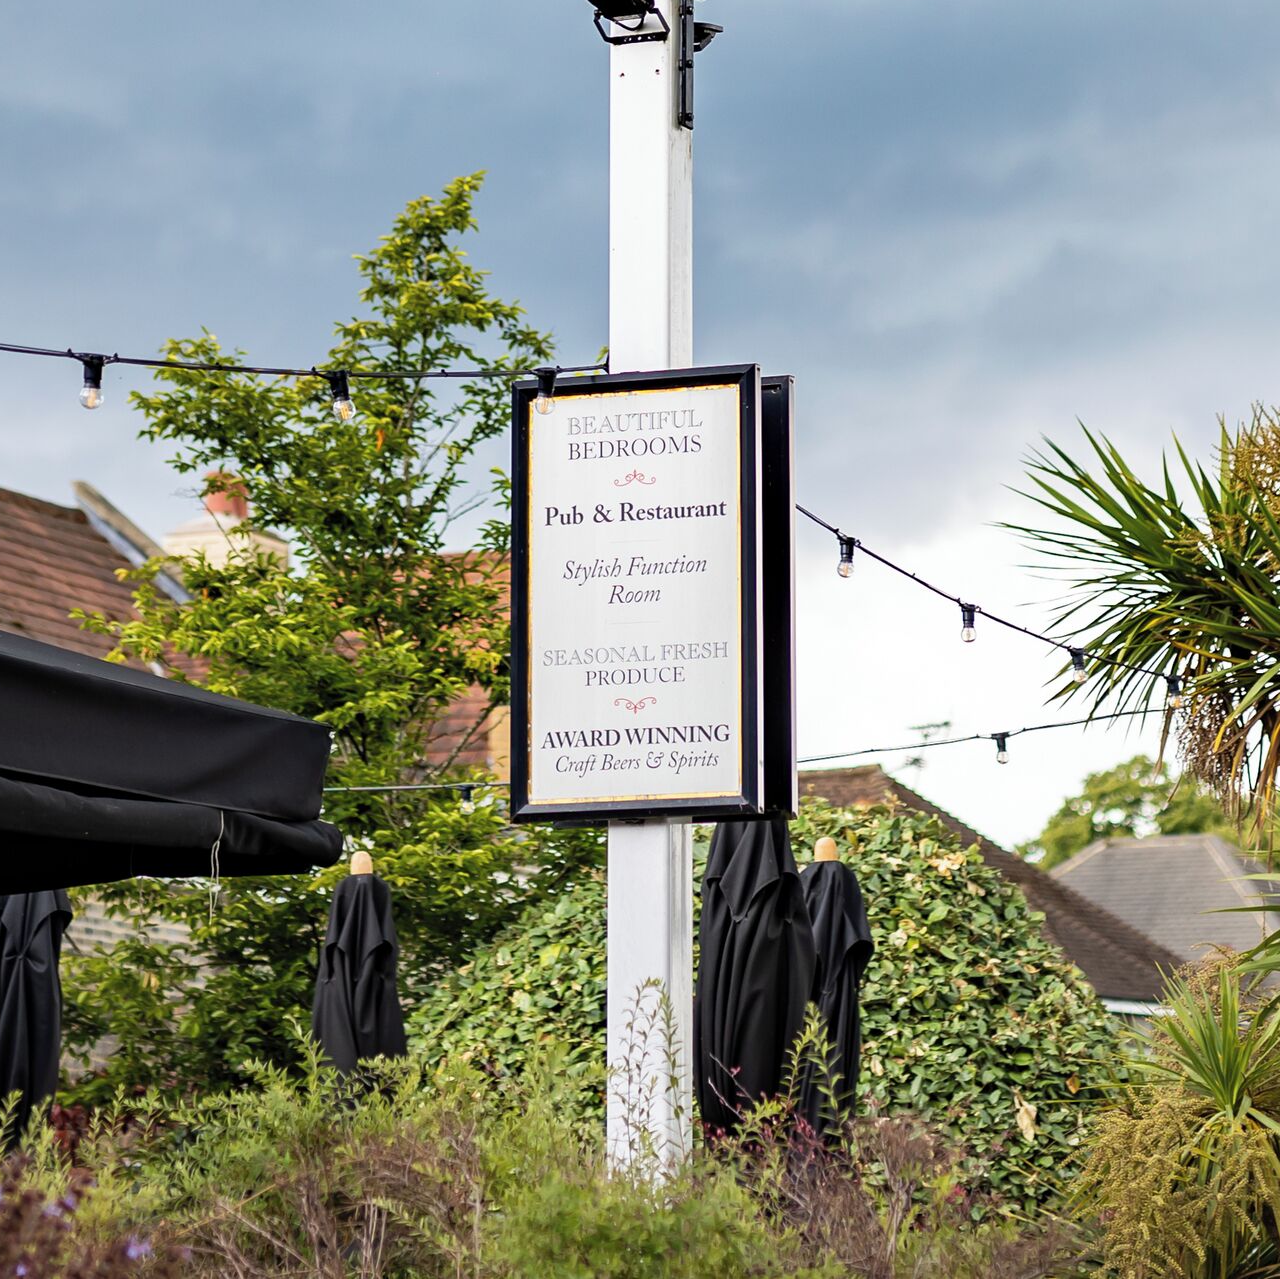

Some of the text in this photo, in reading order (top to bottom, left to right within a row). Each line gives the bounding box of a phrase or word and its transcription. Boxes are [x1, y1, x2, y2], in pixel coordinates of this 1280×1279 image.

[567, 410, 703, 435] BEAUTIFUL
[569, 435, 702, 460] BEDROOMS
[544, 500, 727, 526] Pub & Restaurant
[563, 554, 708, 586] Stylish Function
[608, 584, 662, 605] Room
[543, 641, 729, 667] SEASONAL FRESH
[585, 666, 686, 687] PRODUCE
[541, 724, 731, 750] AWARD WINNING
[556, 750, 719, 777] Craft Beers & Spirits
